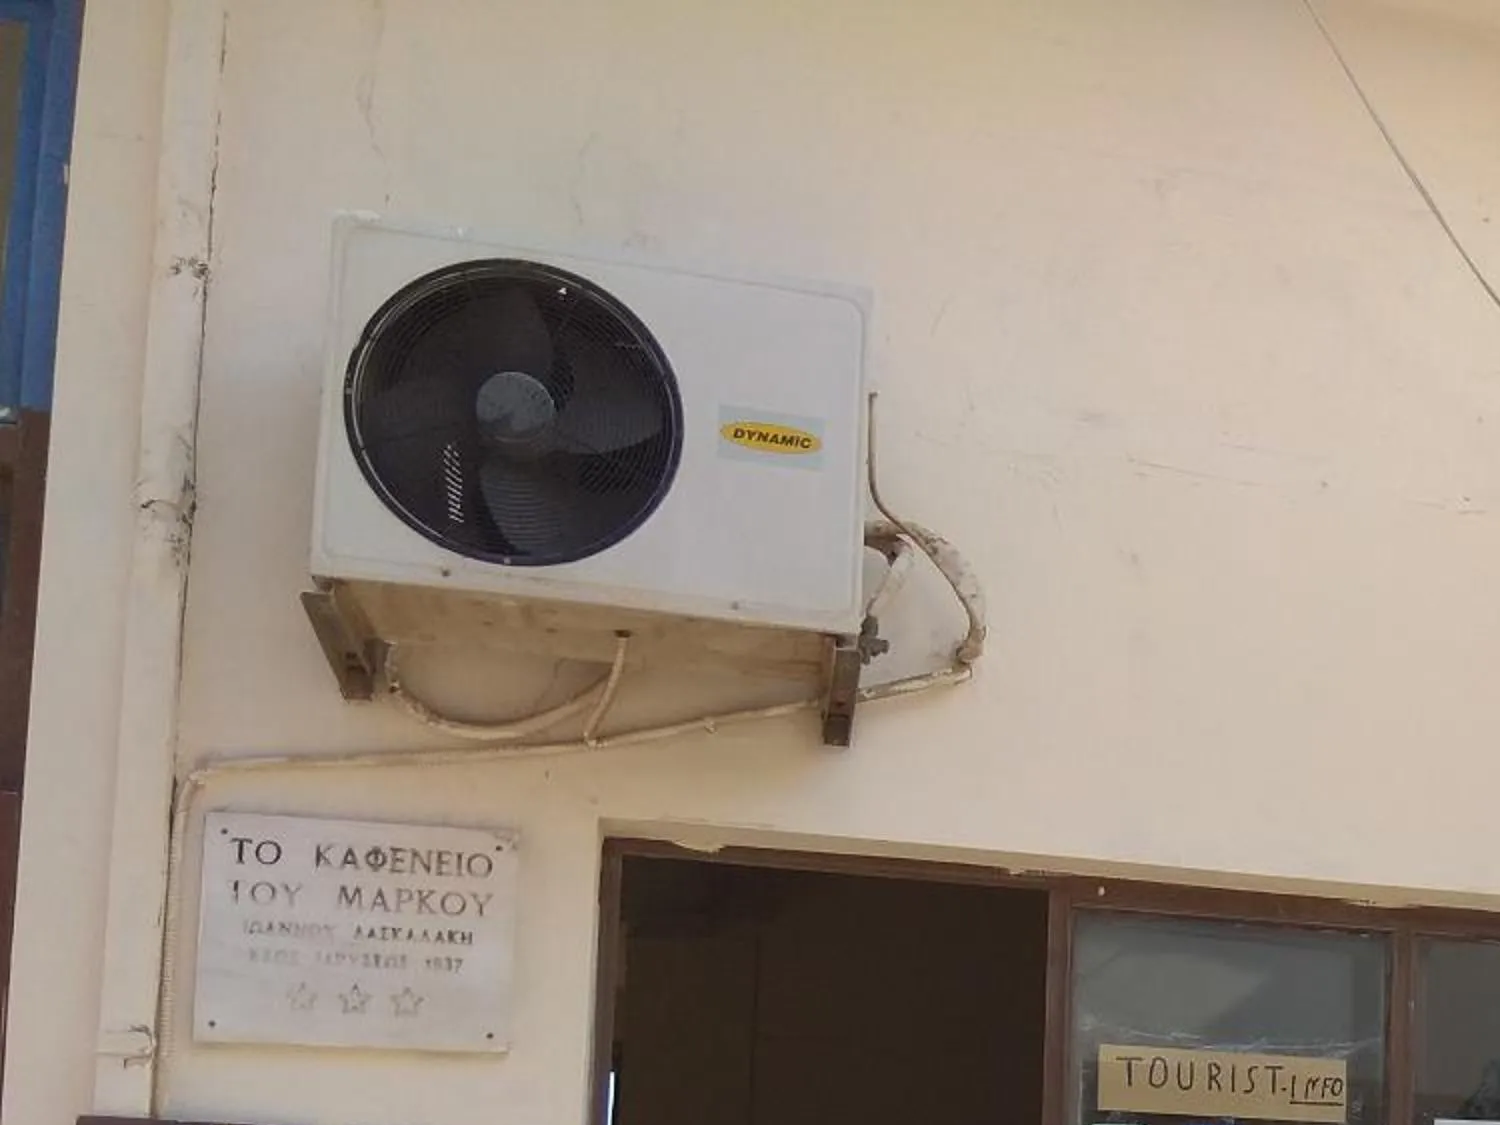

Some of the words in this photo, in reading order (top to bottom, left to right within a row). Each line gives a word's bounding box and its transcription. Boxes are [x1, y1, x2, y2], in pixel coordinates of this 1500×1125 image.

[733, 427, 812, 449] DYNAMIC
[230, 837, 282, 865] ΤΟ
[315, 843, 494, 878] ΚΑΦΕΝΕΙΟ
[337, 885, 493, 917] ΜΑΡΚΟΥ
